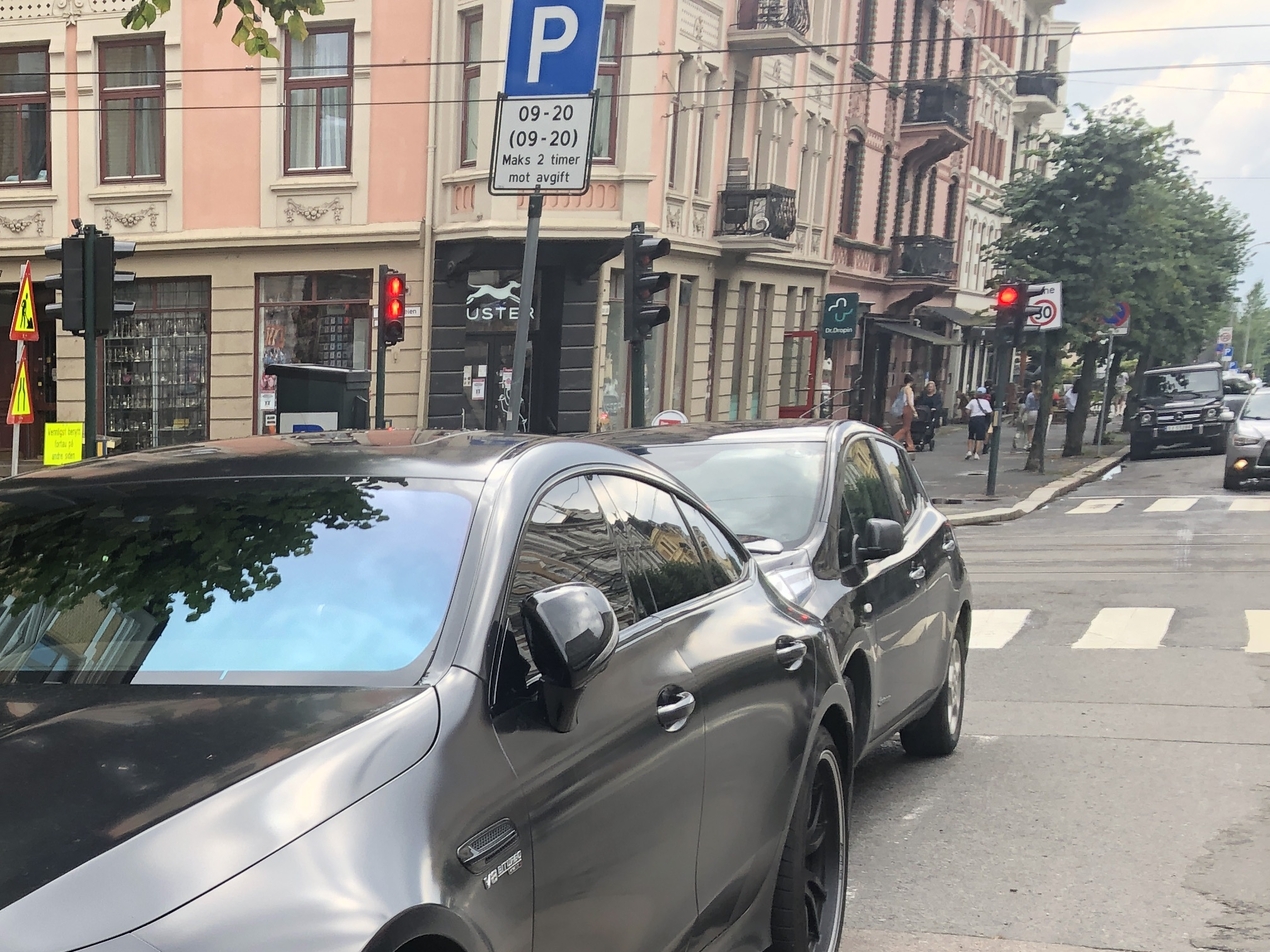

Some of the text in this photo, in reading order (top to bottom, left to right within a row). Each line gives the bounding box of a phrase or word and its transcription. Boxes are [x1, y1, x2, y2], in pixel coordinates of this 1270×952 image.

[527, 5, 579, 83] P
[502, 153, 580, 166] Maks 2 timer
[509, 171, 570, 186] mot avgift
